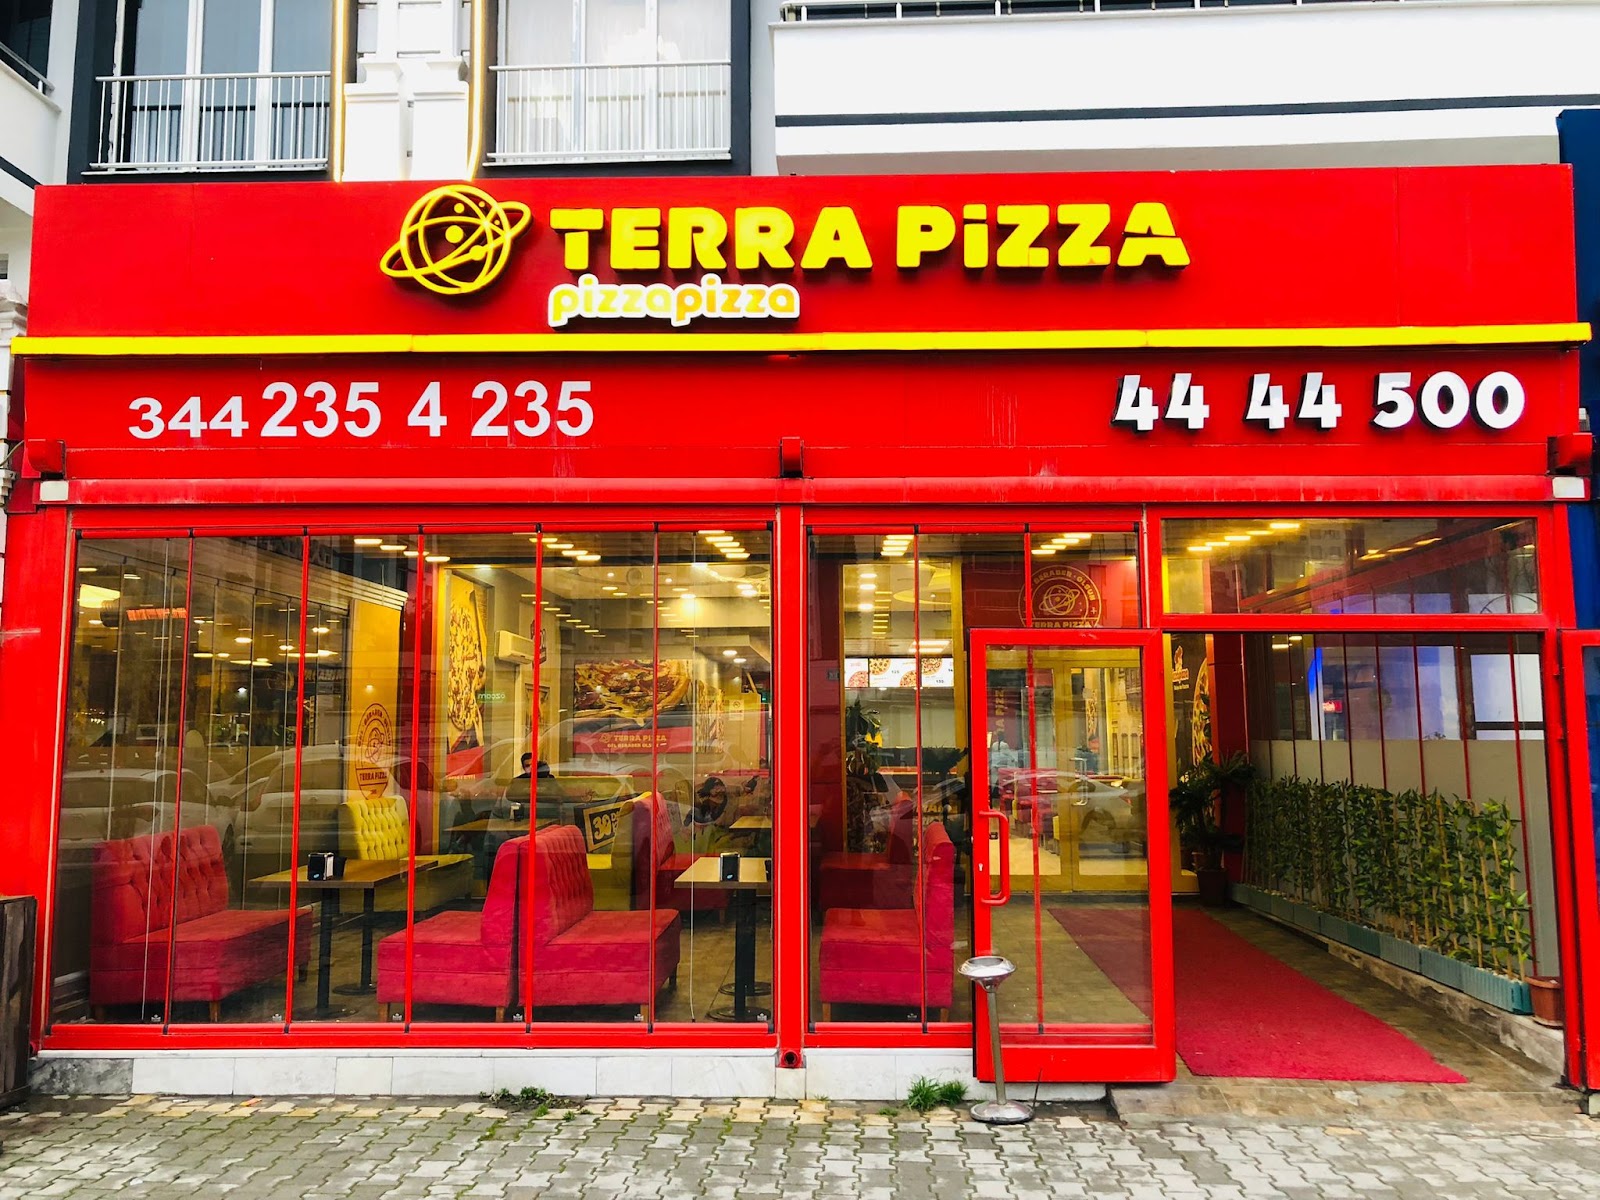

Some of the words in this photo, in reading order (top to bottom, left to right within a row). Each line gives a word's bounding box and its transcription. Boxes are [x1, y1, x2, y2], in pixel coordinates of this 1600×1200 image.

[549, 206, 874, 271] TERRA
[128, 396, 249, 439] 344
[260, 380, 382, 438] 235
[407, 381, 448, 438] 4
[471, 379, 594, 438] 235
[1114, 372, 1210, 431] 44
[1246, 371, 1343, 430] 44
[1374, 370, 1526, 430] 500
